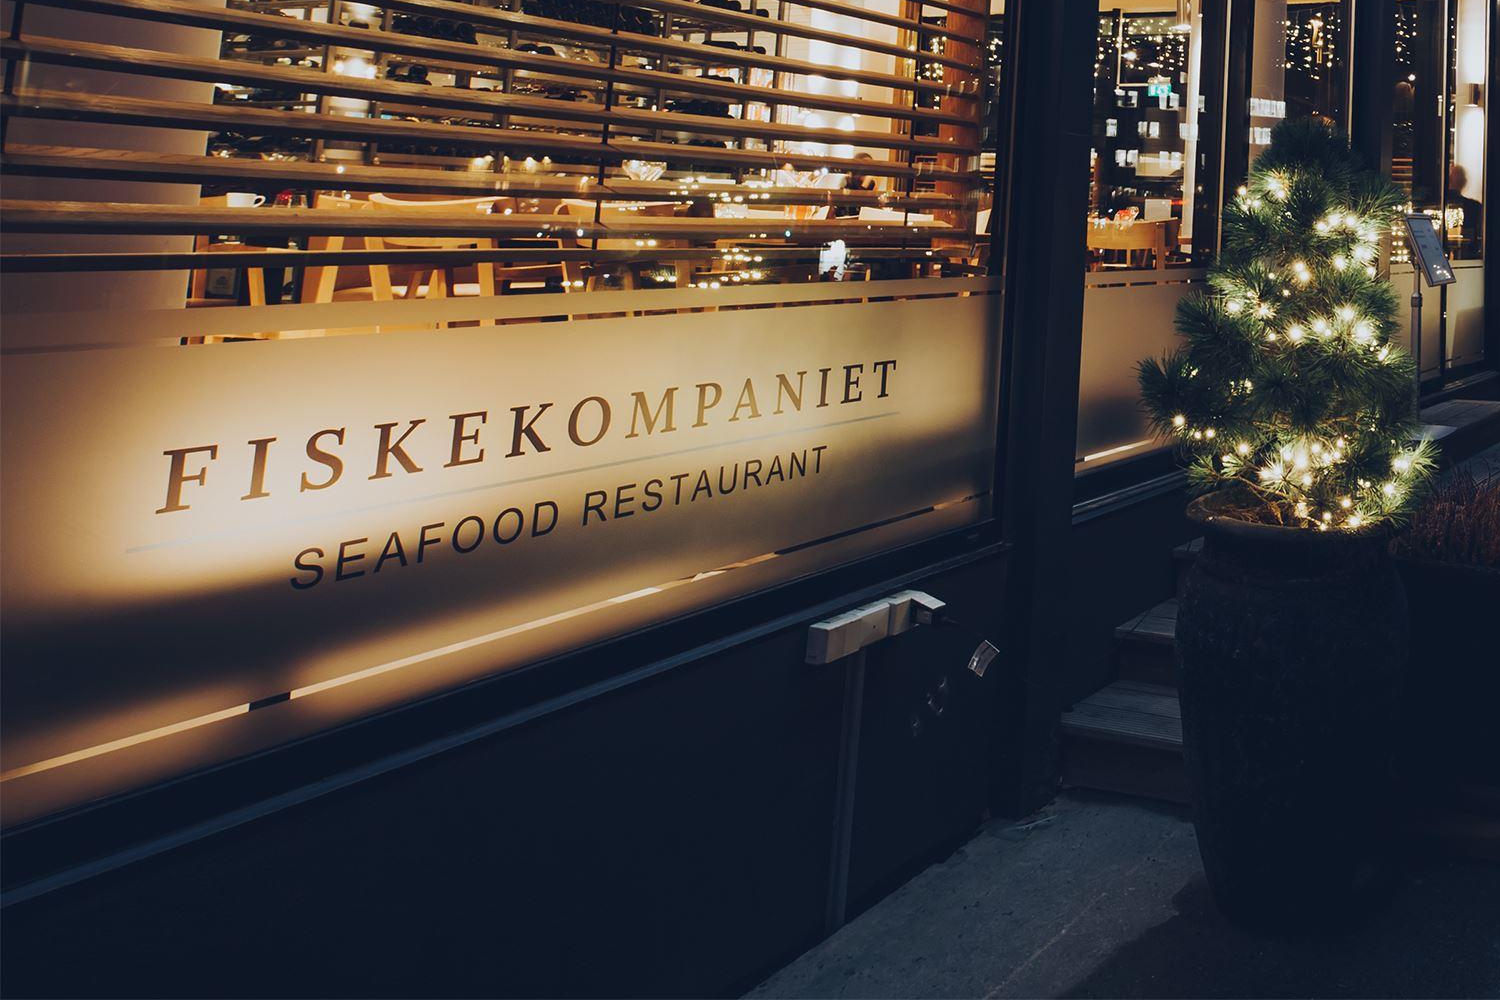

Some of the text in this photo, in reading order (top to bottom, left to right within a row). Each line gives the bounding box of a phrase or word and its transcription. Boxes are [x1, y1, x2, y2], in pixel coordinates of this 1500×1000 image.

[155, 359, 899, 515] FISKEKOMPANIET
[290, 445, 828, 590] SEAFOOD RESTAURANT
